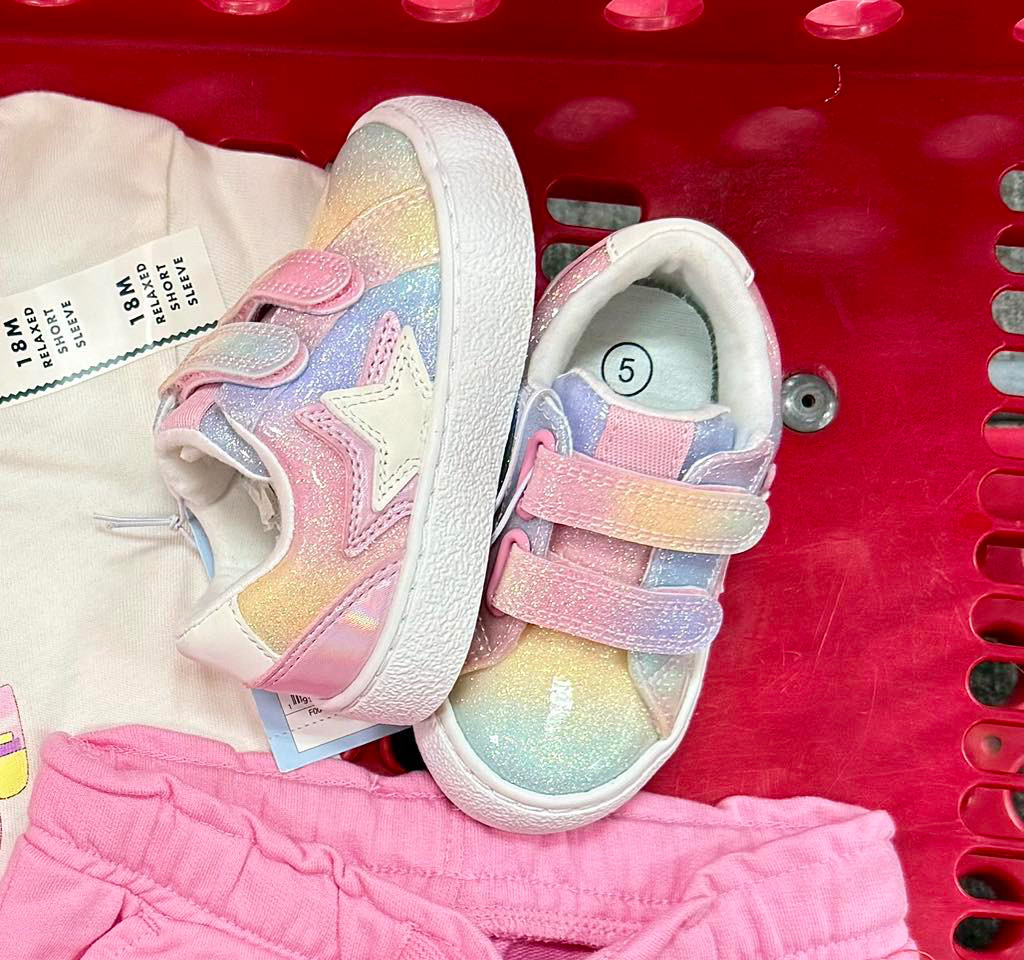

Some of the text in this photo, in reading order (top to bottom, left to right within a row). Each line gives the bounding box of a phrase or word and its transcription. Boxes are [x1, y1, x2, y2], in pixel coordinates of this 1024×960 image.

[116, 276, 145, 326] 18M
[136, 263, 166, 324] RELAXED
[156, 265, 181, 311] SHORT
[173, 257, 198, 306] SLEEVE
[3, 317, 32, 367] 18M
[24, 307, 53, 368] RELAXED
[43, 309, 68, 354] SHORT
[61, 300, 86, 348] SLEEVE
[618, 358, 635, 383] 5
